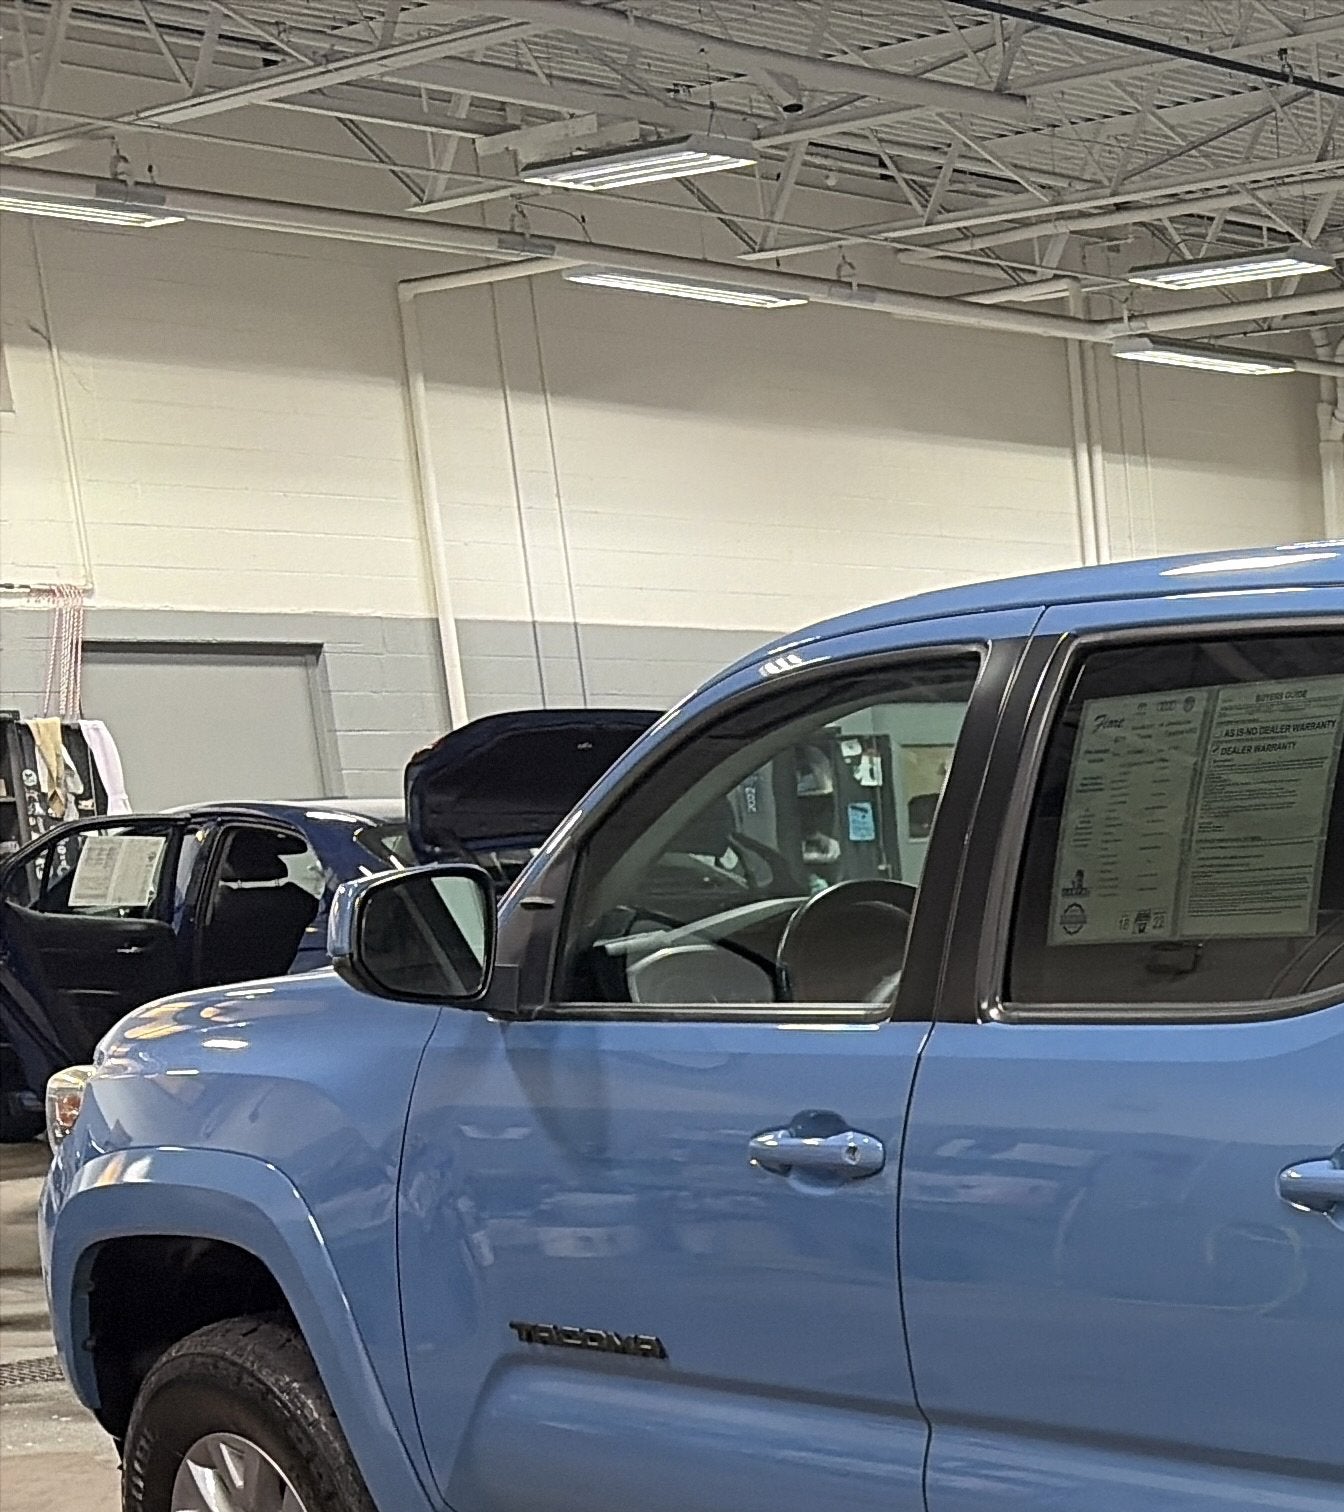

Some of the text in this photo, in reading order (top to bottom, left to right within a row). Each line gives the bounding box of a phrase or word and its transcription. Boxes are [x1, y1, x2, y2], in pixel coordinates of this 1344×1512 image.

[1259, 723, 1291, 735] DEALER
[1292, 719, 1337, 732] WARRANTY
[1220, 741, 1297, 756] DEALER WARRANTY
[508, 1319, 670, 1360] TACOMA
